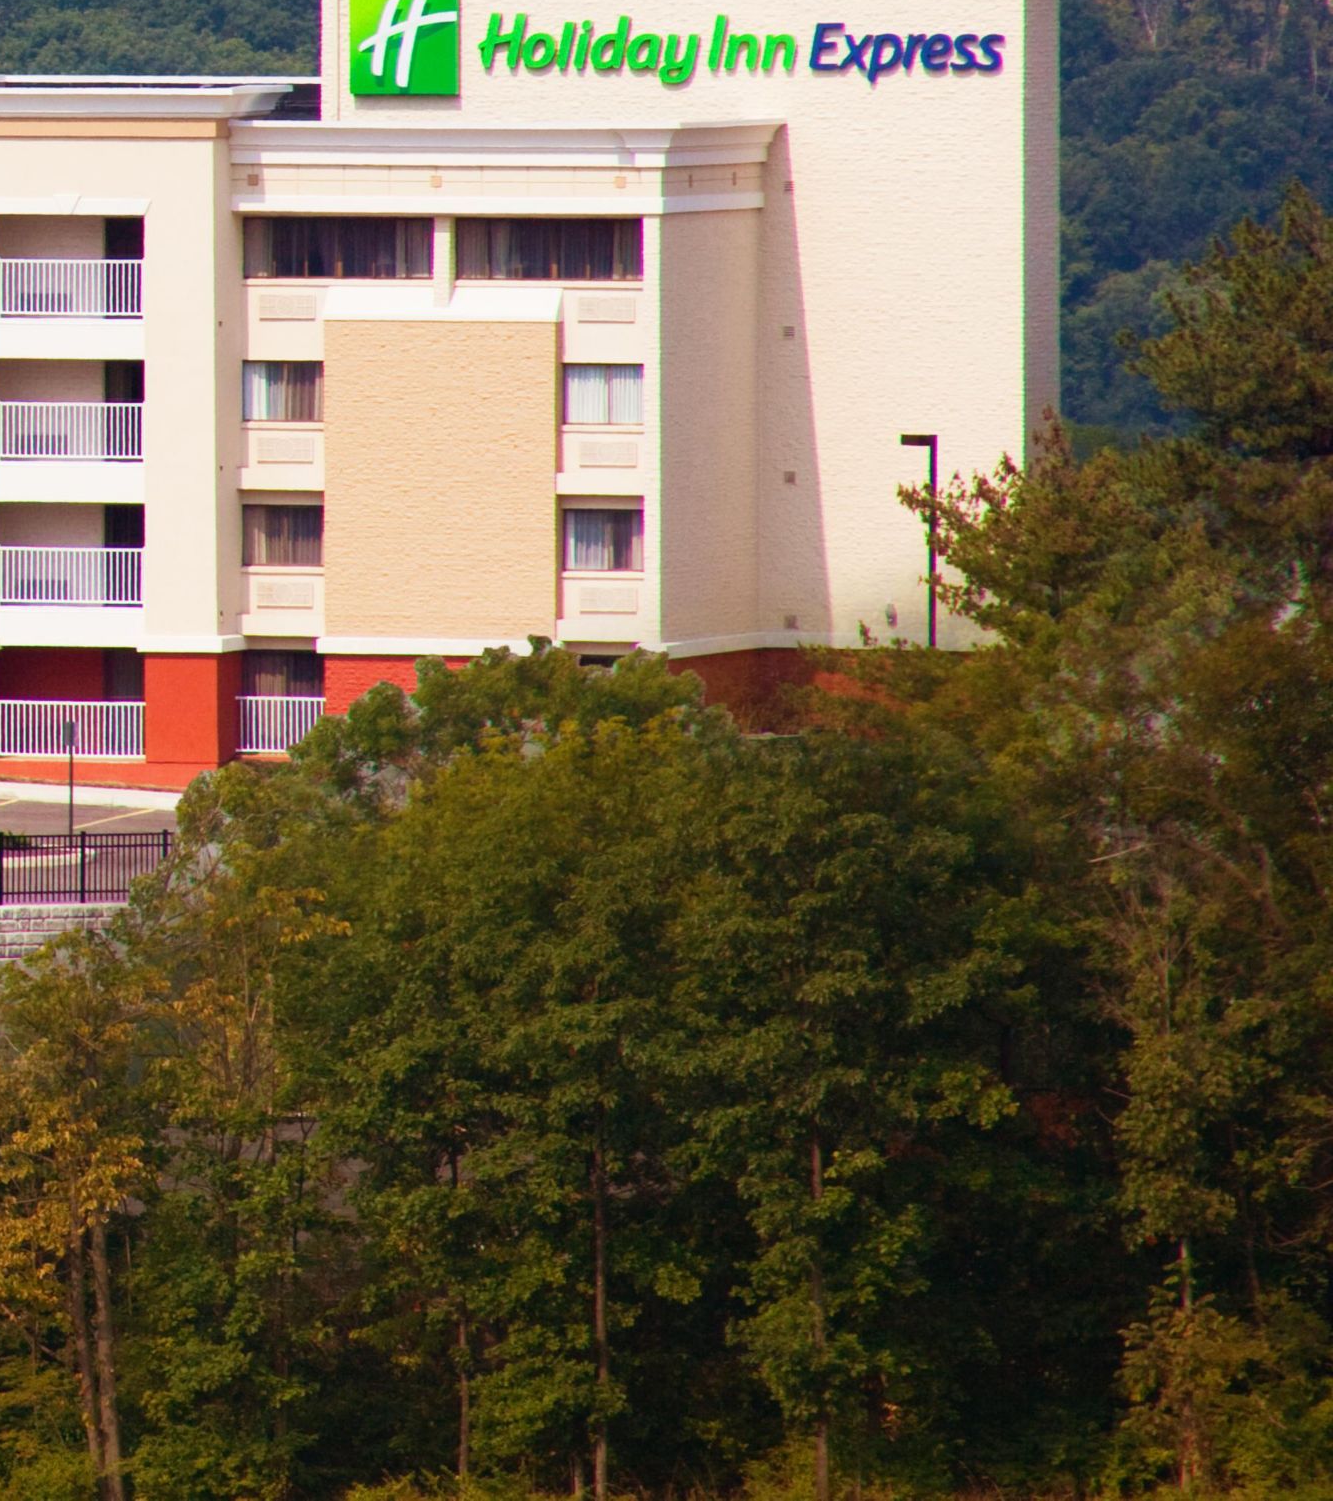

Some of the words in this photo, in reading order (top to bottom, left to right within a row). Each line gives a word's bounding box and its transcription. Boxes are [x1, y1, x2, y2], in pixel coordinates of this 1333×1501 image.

[478, 12, 699, 84] Holiday
[707, 14, 797, 71] Inn
[808, 22, 1005, 84] Express
